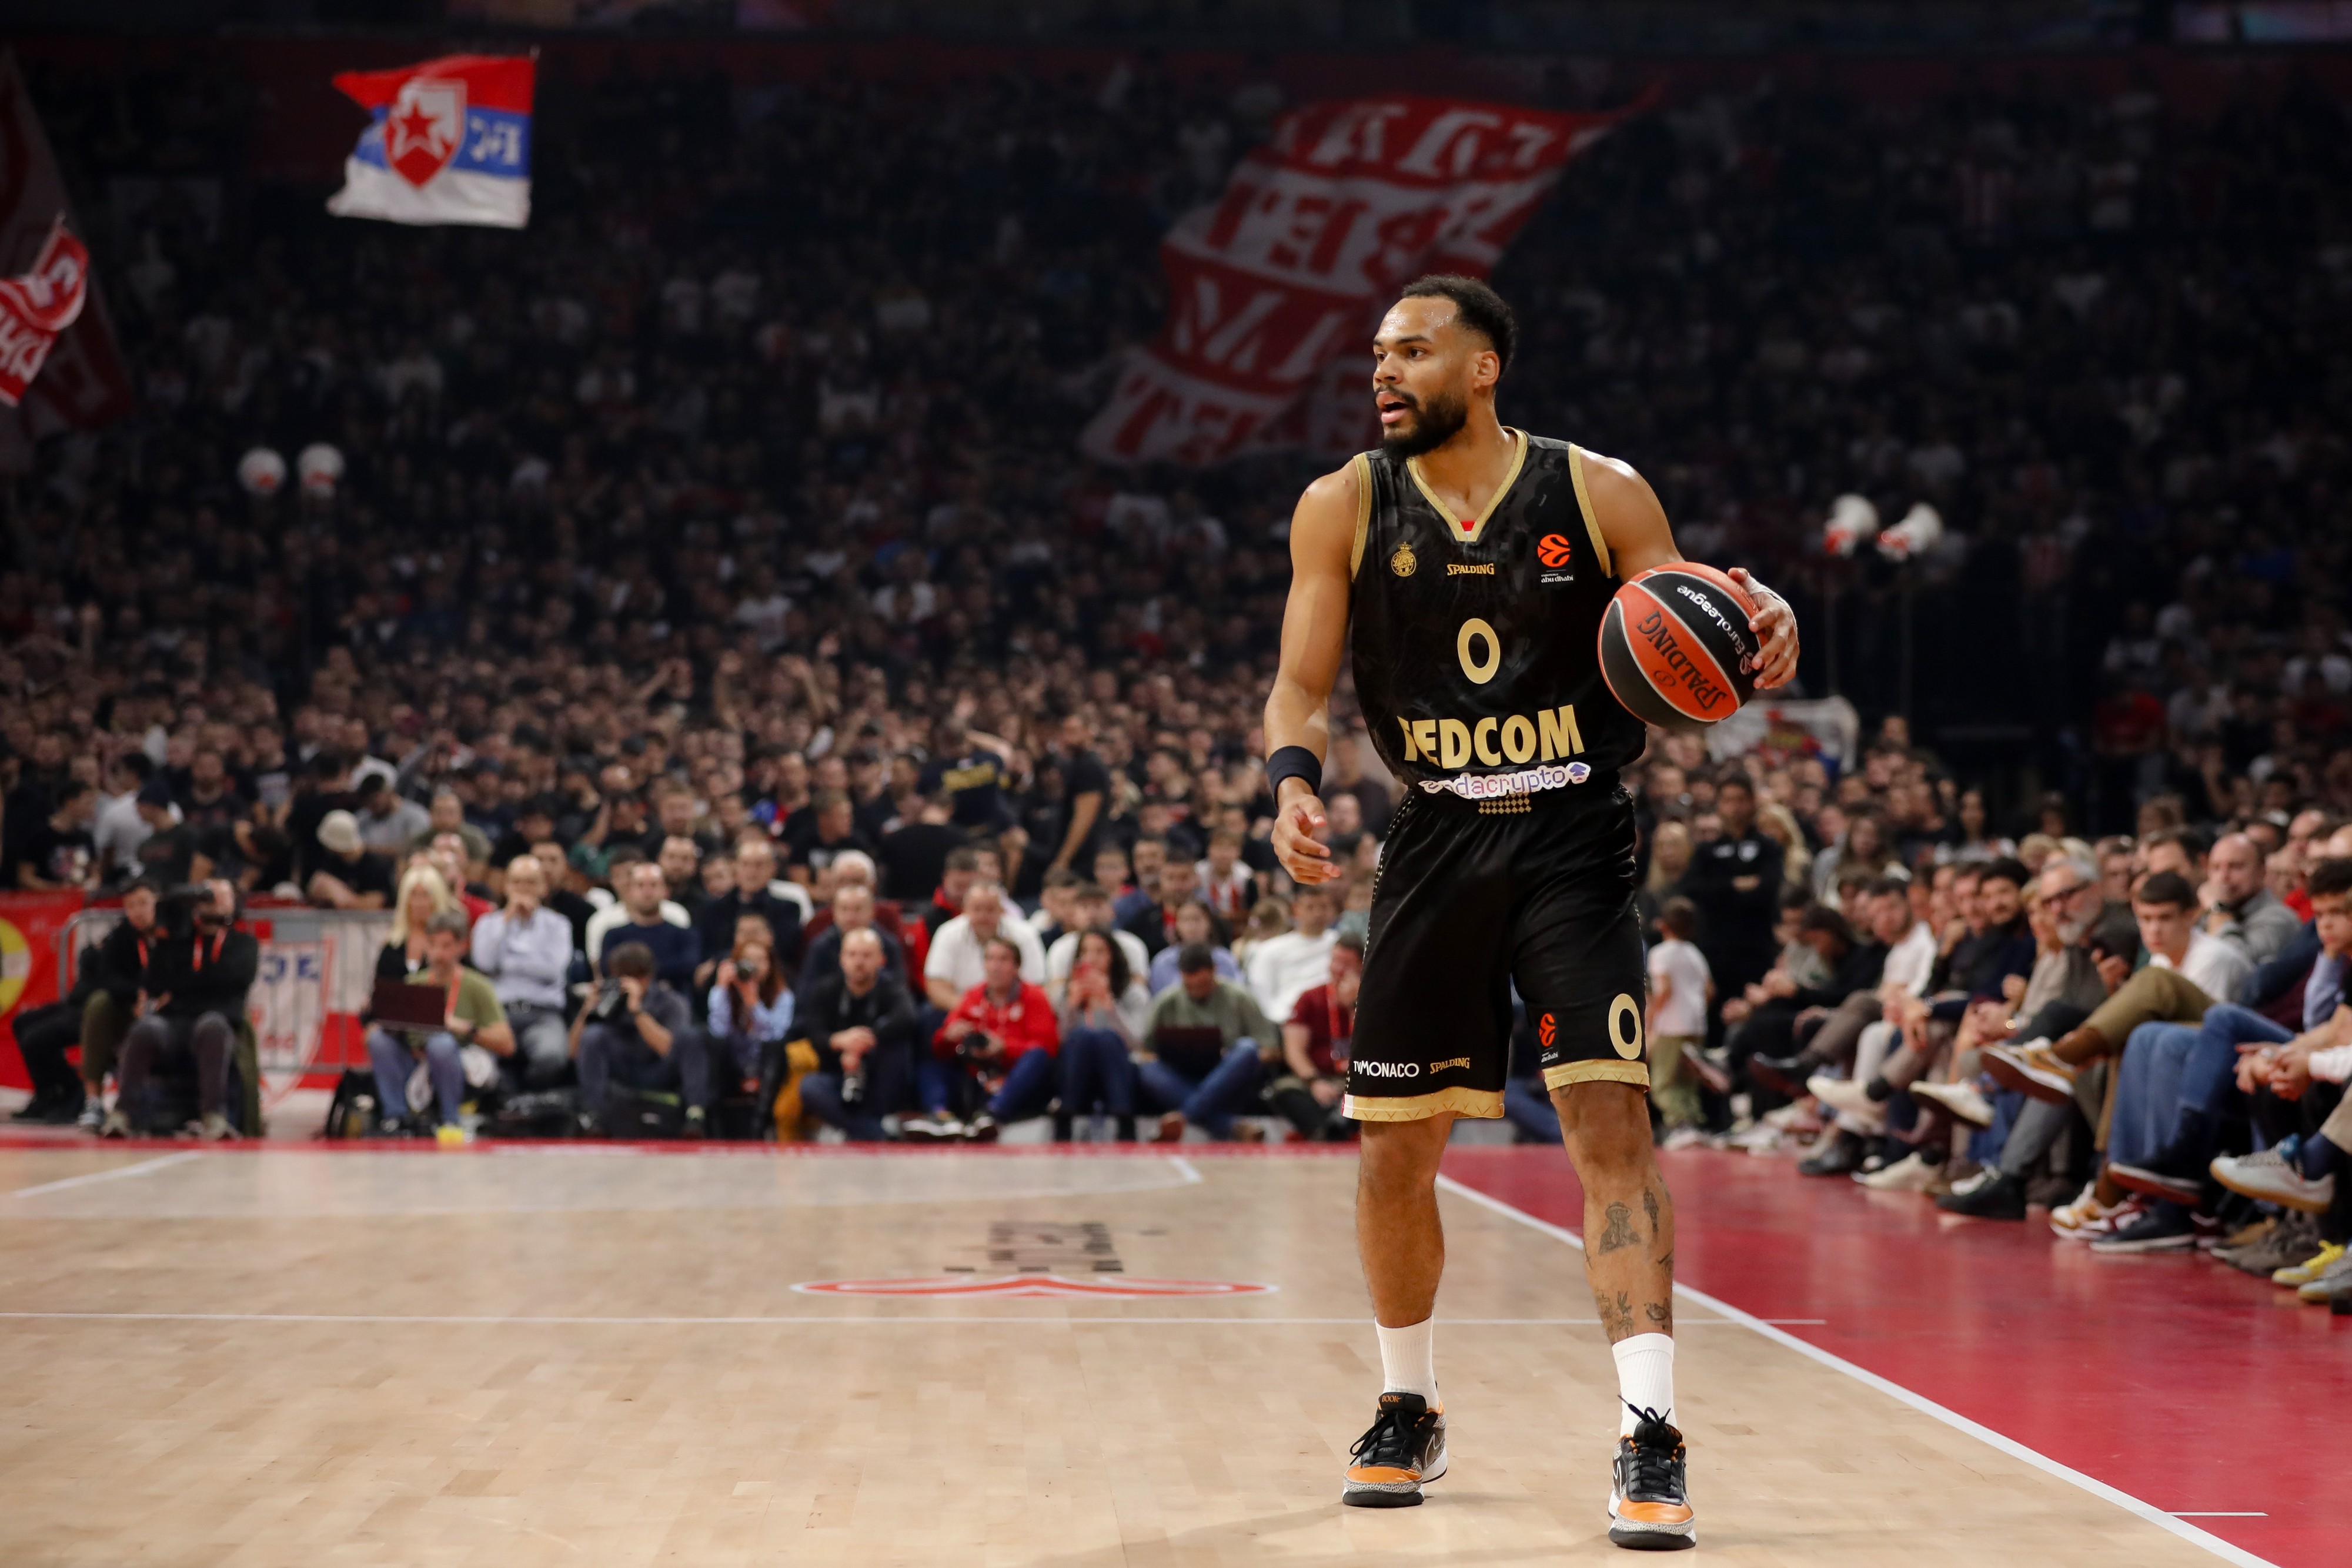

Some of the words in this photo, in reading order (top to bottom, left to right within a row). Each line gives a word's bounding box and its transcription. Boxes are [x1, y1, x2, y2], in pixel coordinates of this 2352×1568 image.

[1446, 563, 1495, 576] SPALDING
[1457, 618, 1501, 684] 0
[1676, 585, 1746, 656] EuroLeague
[1636, 611, 1728, 710] SPALDING
[1608, 993, 1642, 1060] 0
[1430, 1057, 1470, 1074] SPALDING
[1381, 1395, 1399, 1403] BOOK
